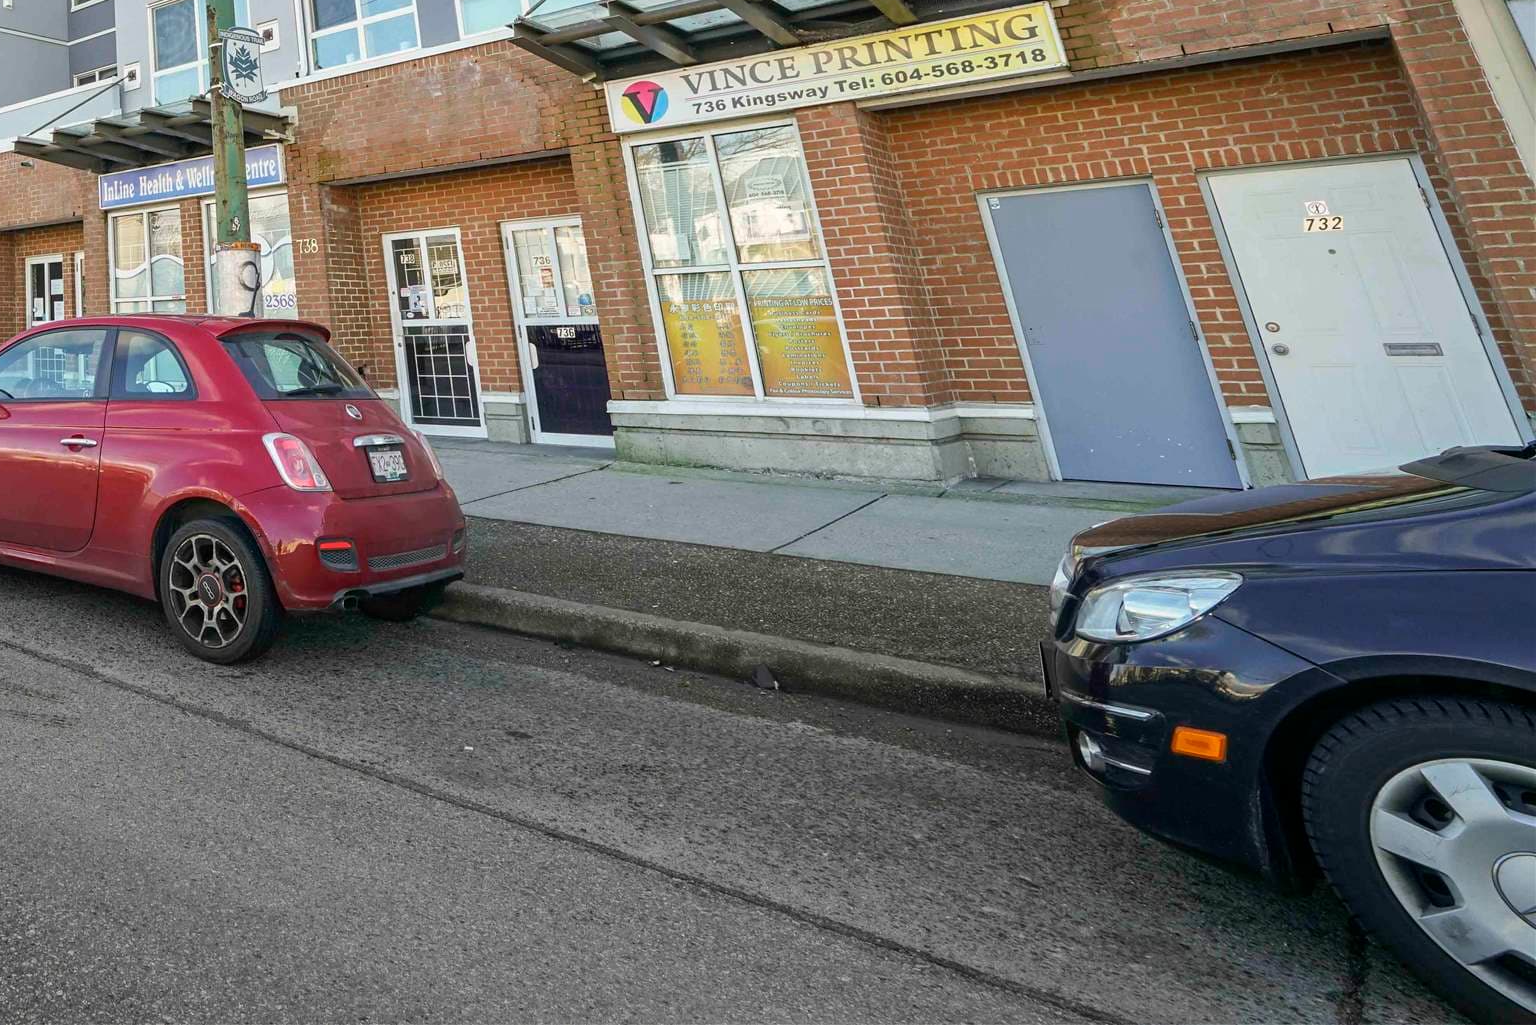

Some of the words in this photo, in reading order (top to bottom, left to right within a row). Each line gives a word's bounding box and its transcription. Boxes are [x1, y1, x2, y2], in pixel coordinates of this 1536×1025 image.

[251, 36, 264, 45] TRAIL
[680, 56, 800, 95] VINCE
[808, 13, 1039, 75] PRINTING
[692, 99, 726, 115] 736
[731, 85, 829, 110] Kingsway
[834, 76, 876, 93] Tel:
[881, 48, 1047, 86] 604-568-3718
[228, 88, 248, 102] WAGON
[622, 87, 664, 124] V
[103, 180, 136, 202] InLine
[139, 173, 173, 197] Health
[175, 170, 185, 191] &
[186, 164, 214, 189] Well
[245, 158, 276, 180] entre
[1305, 216, 1342, 232] 732
[296, 238, 319, 254] 738
[533, 256, 551, 265] 736
[265, 293, 296, 308] 2368
[809, 297, 833, 306] PRICES
[557, 327, 575, 338] 736
